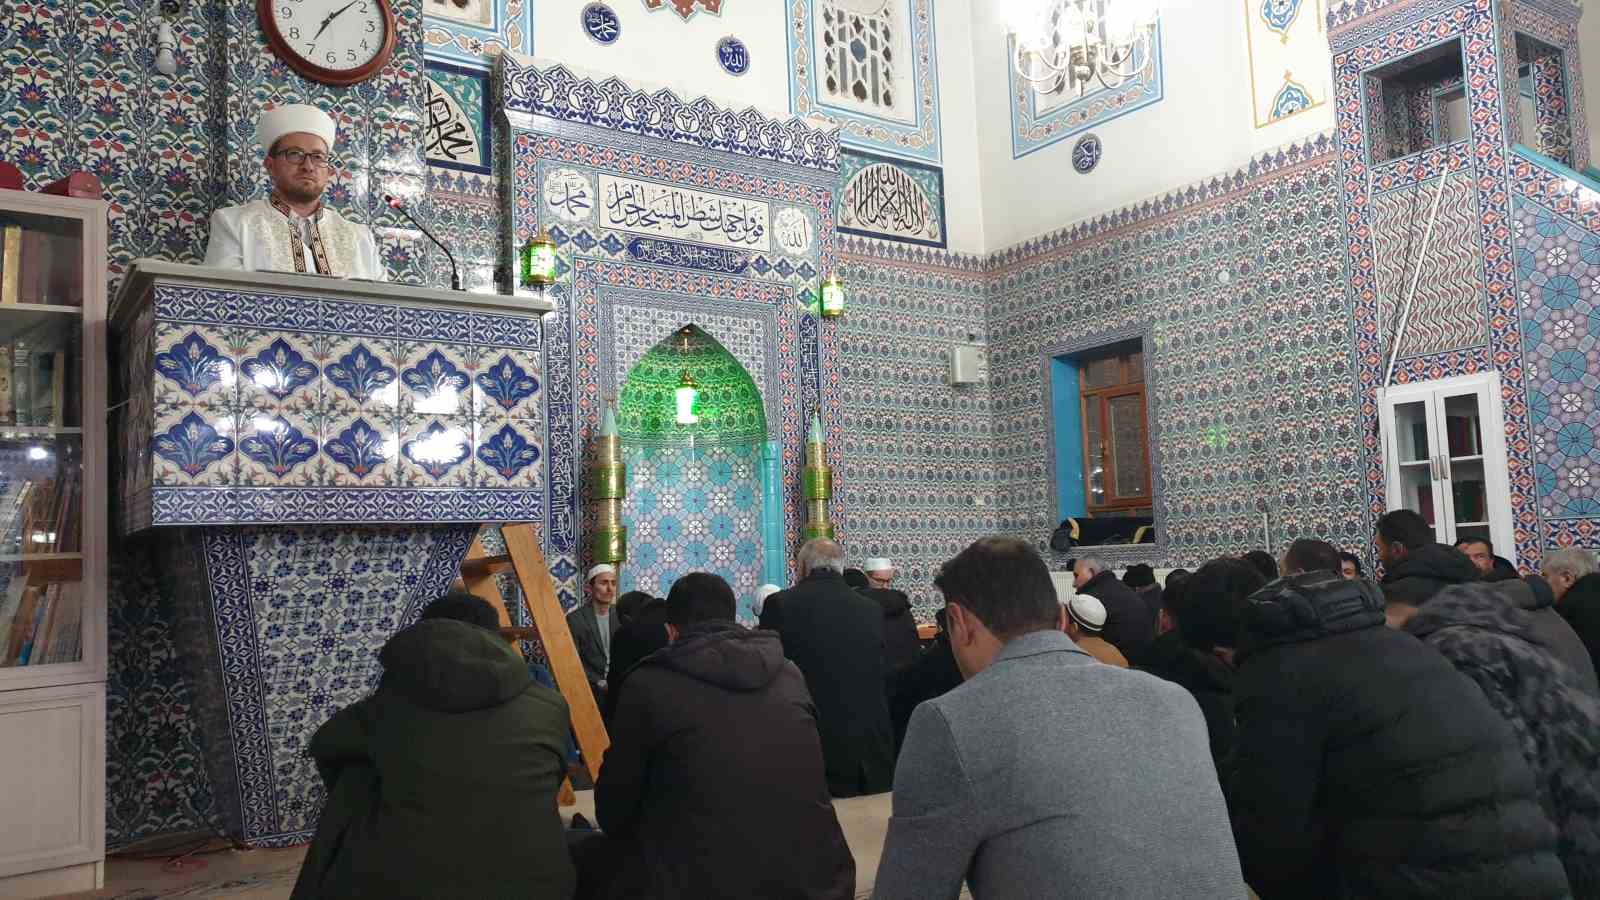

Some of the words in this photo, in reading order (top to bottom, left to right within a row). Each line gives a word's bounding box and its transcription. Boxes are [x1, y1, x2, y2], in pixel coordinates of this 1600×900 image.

[281, 7, 292, 19] 9
[358, 1, 368, 13] 2
[365, 20, 376, 33] 3
[289, 27, 300, 40] 8
[306, 43, 316, 55] 7
[359, 38, 369, 51] 4
[326, 51, 337, 64] 6
[346, 50, 357, 62] 5
